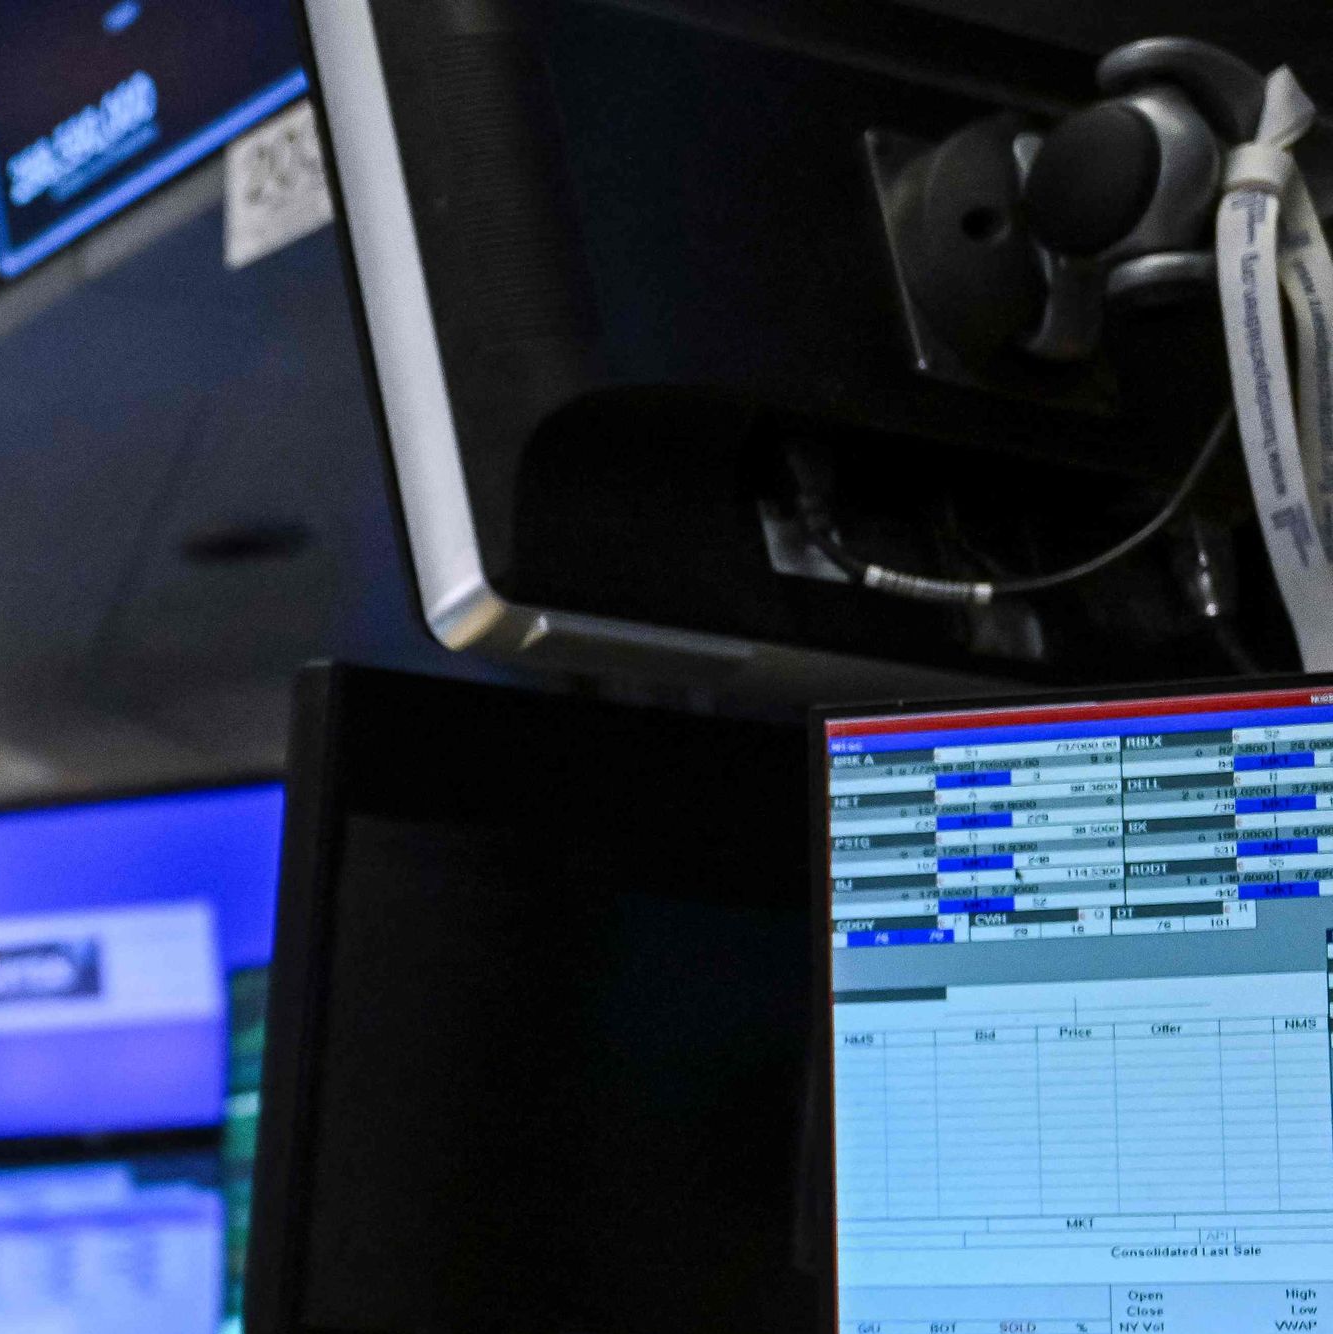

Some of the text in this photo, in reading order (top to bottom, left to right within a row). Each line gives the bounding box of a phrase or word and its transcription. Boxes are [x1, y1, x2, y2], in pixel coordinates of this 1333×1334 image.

[1261, 754, 1289, 767] MKT
[1262, 797, 1290, 809] MKT
[1264, 839, 1292, 852] MKT
[1265, 883, 1294, 895] MKT
[974, 1028, 997, 1042] Bid
[1059, 1025, 1094, 1039] Price
[1151, 1021, 1183, 1036] Offer
[1284, 1018, 1317, 1032] NMS
[1111, 1244, 1262, 1258] Consolidated Last Sale
[1128, 1287, 1317, 1304] Open High
[1126, 1304, 1318, 1318] Close Low
[999, 1320, 1037, 1334] SOLD
[1119, 1319, 1318, 1333] NY Vol VWAP
